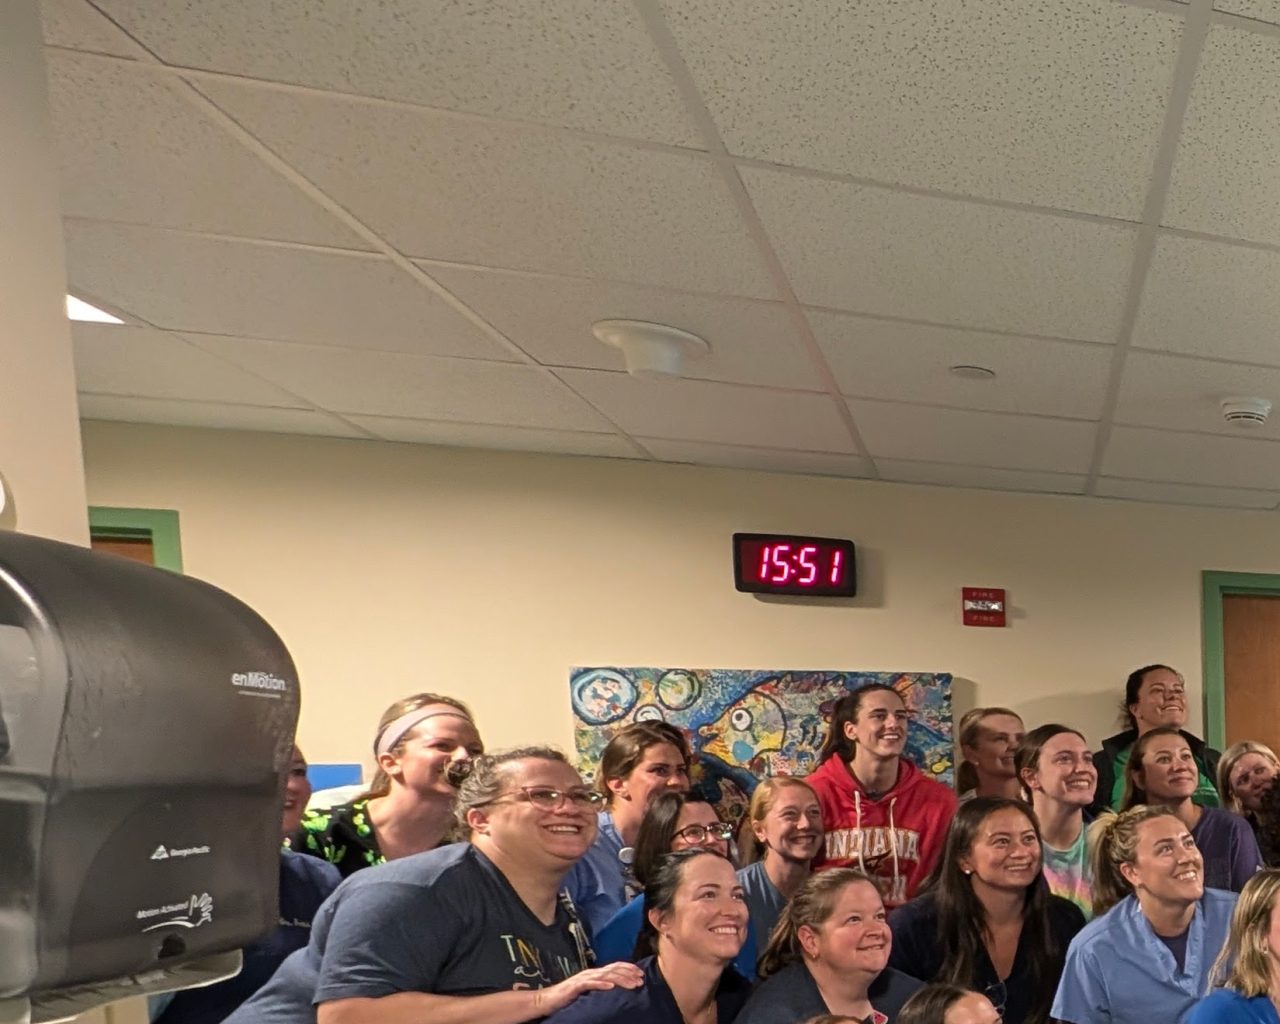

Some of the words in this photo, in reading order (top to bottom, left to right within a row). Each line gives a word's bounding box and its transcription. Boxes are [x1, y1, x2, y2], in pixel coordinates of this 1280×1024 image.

[761, 546, 840, 583] 15:51
[232, 671, 287, 691] enMotion
[824, 827, 920, 861] INDIANA
